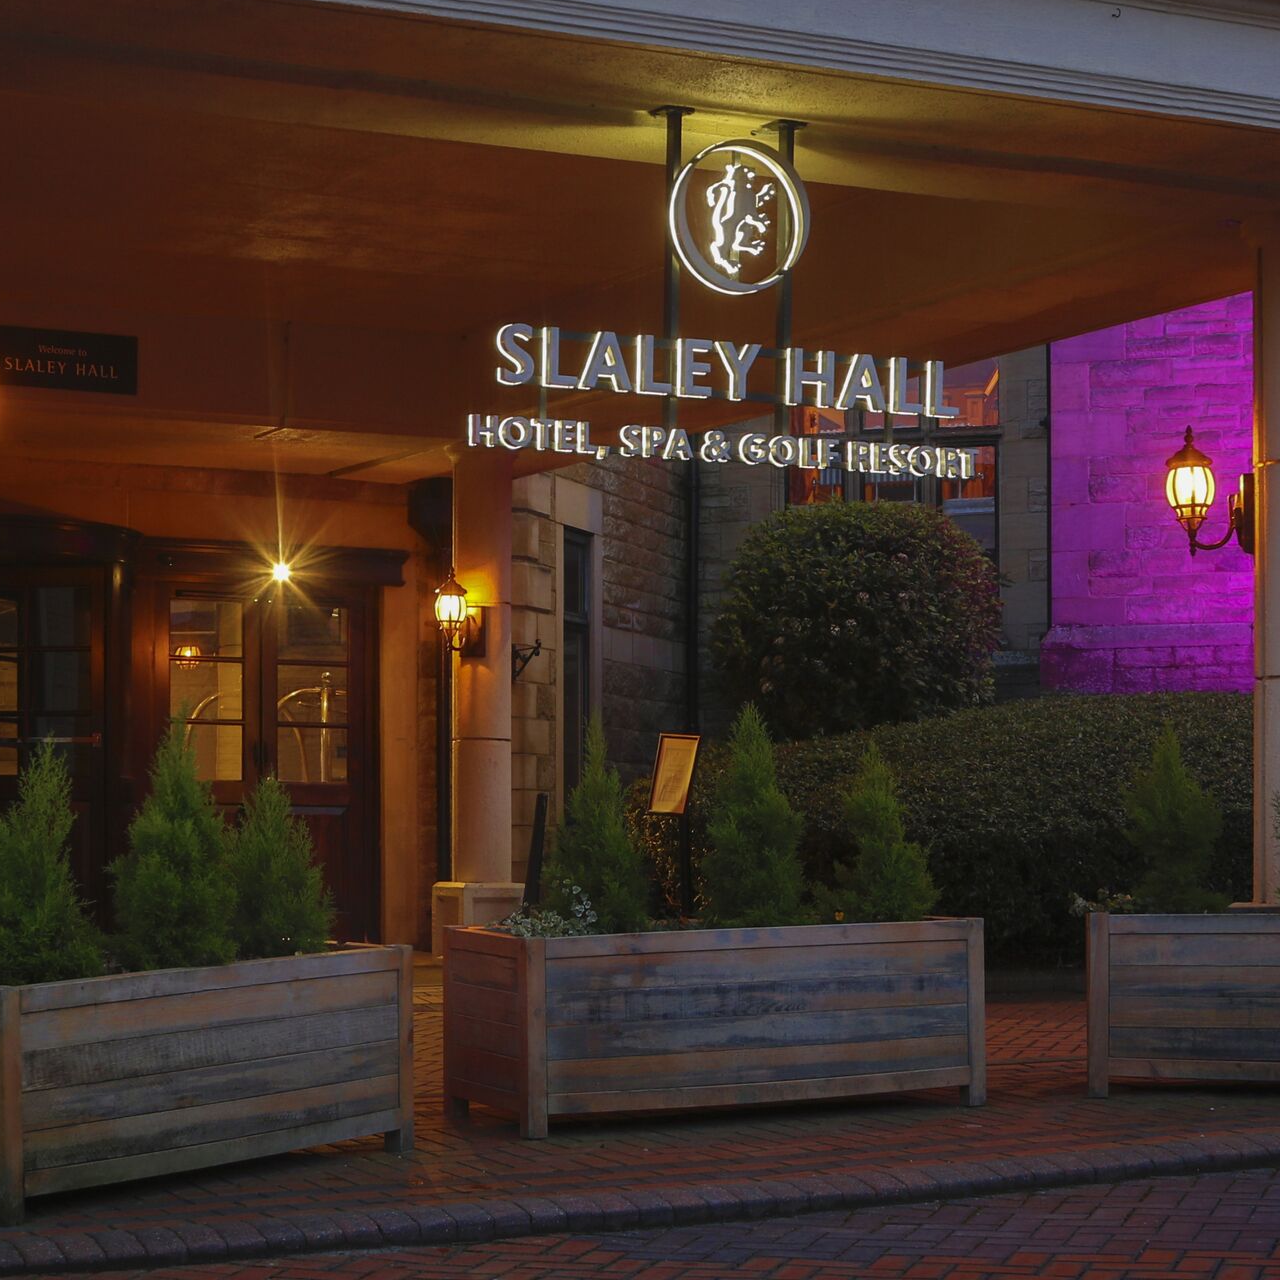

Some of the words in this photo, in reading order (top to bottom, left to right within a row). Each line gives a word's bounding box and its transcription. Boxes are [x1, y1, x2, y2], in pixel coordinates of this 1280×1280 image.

[4, 356, 66, 375] SLALEY
[75, 363, 118, 379] HALL
[38, 344, 76, 356] Welcome
[78, 348, 87, 357] to
[496, 323, 761, 402] SLALEY
[784, 347, 960, 419] HALL
[467, 413, 610, 460] HOTEL,
[620, 424, 694, 461] SPA
[701, 430, 731, 463] &
[738, 433, 839, 470] GOLF
[847, 441, 980, 480] RESORT
